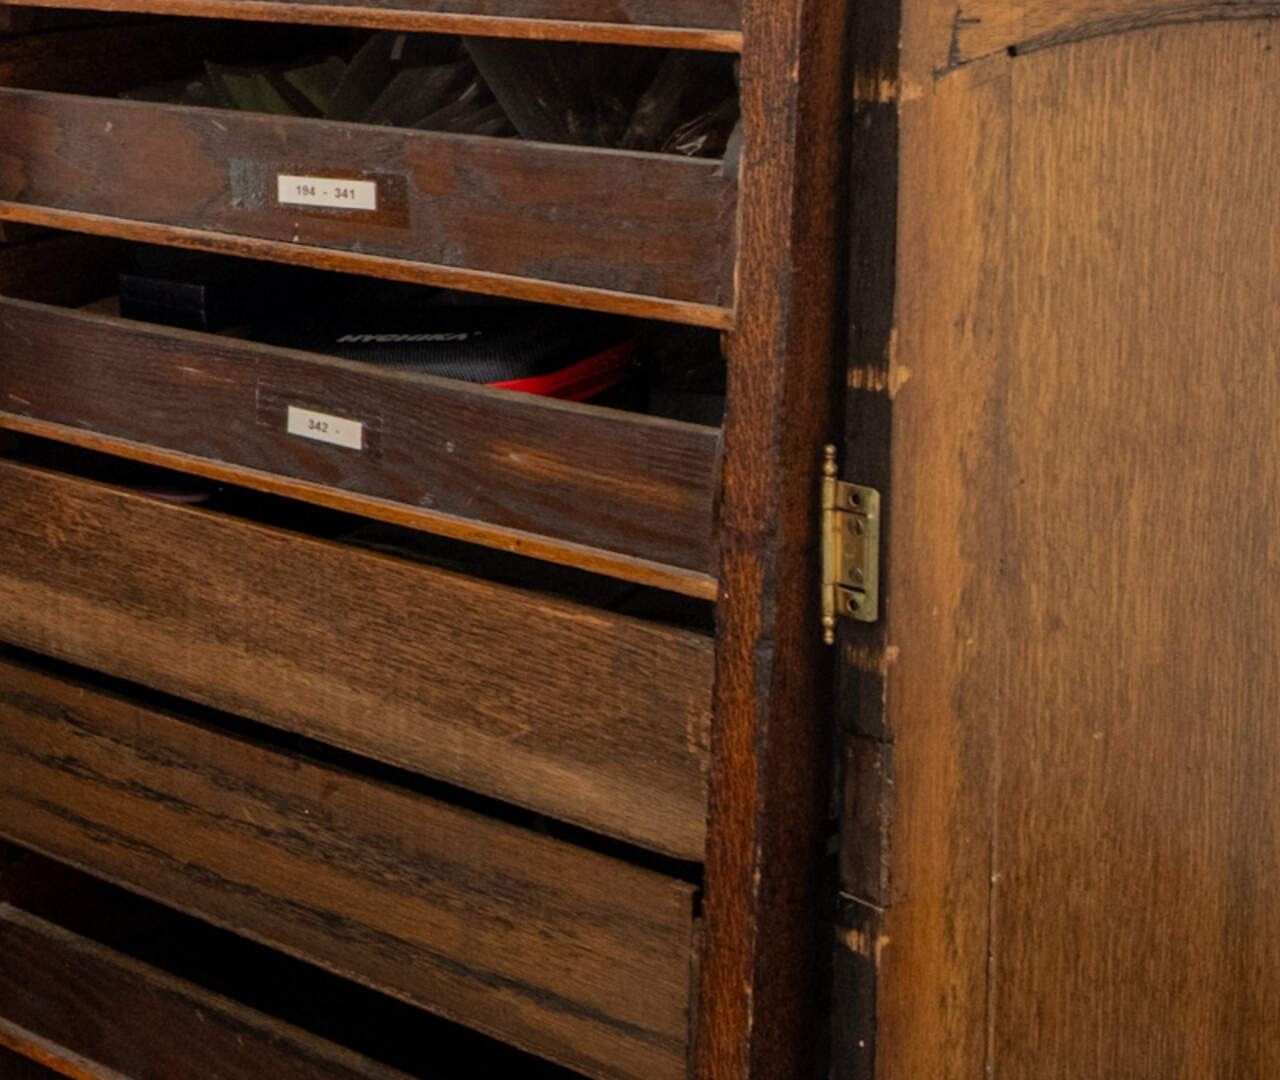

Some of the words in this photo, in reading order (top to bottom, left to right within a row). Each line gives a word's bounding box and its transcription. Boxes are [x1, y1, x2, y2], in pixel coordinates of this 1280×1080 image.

[296, 185, 316, 196] 194
[334, 188, 356, 200] 341
[307, 419, 329, 433] 342
